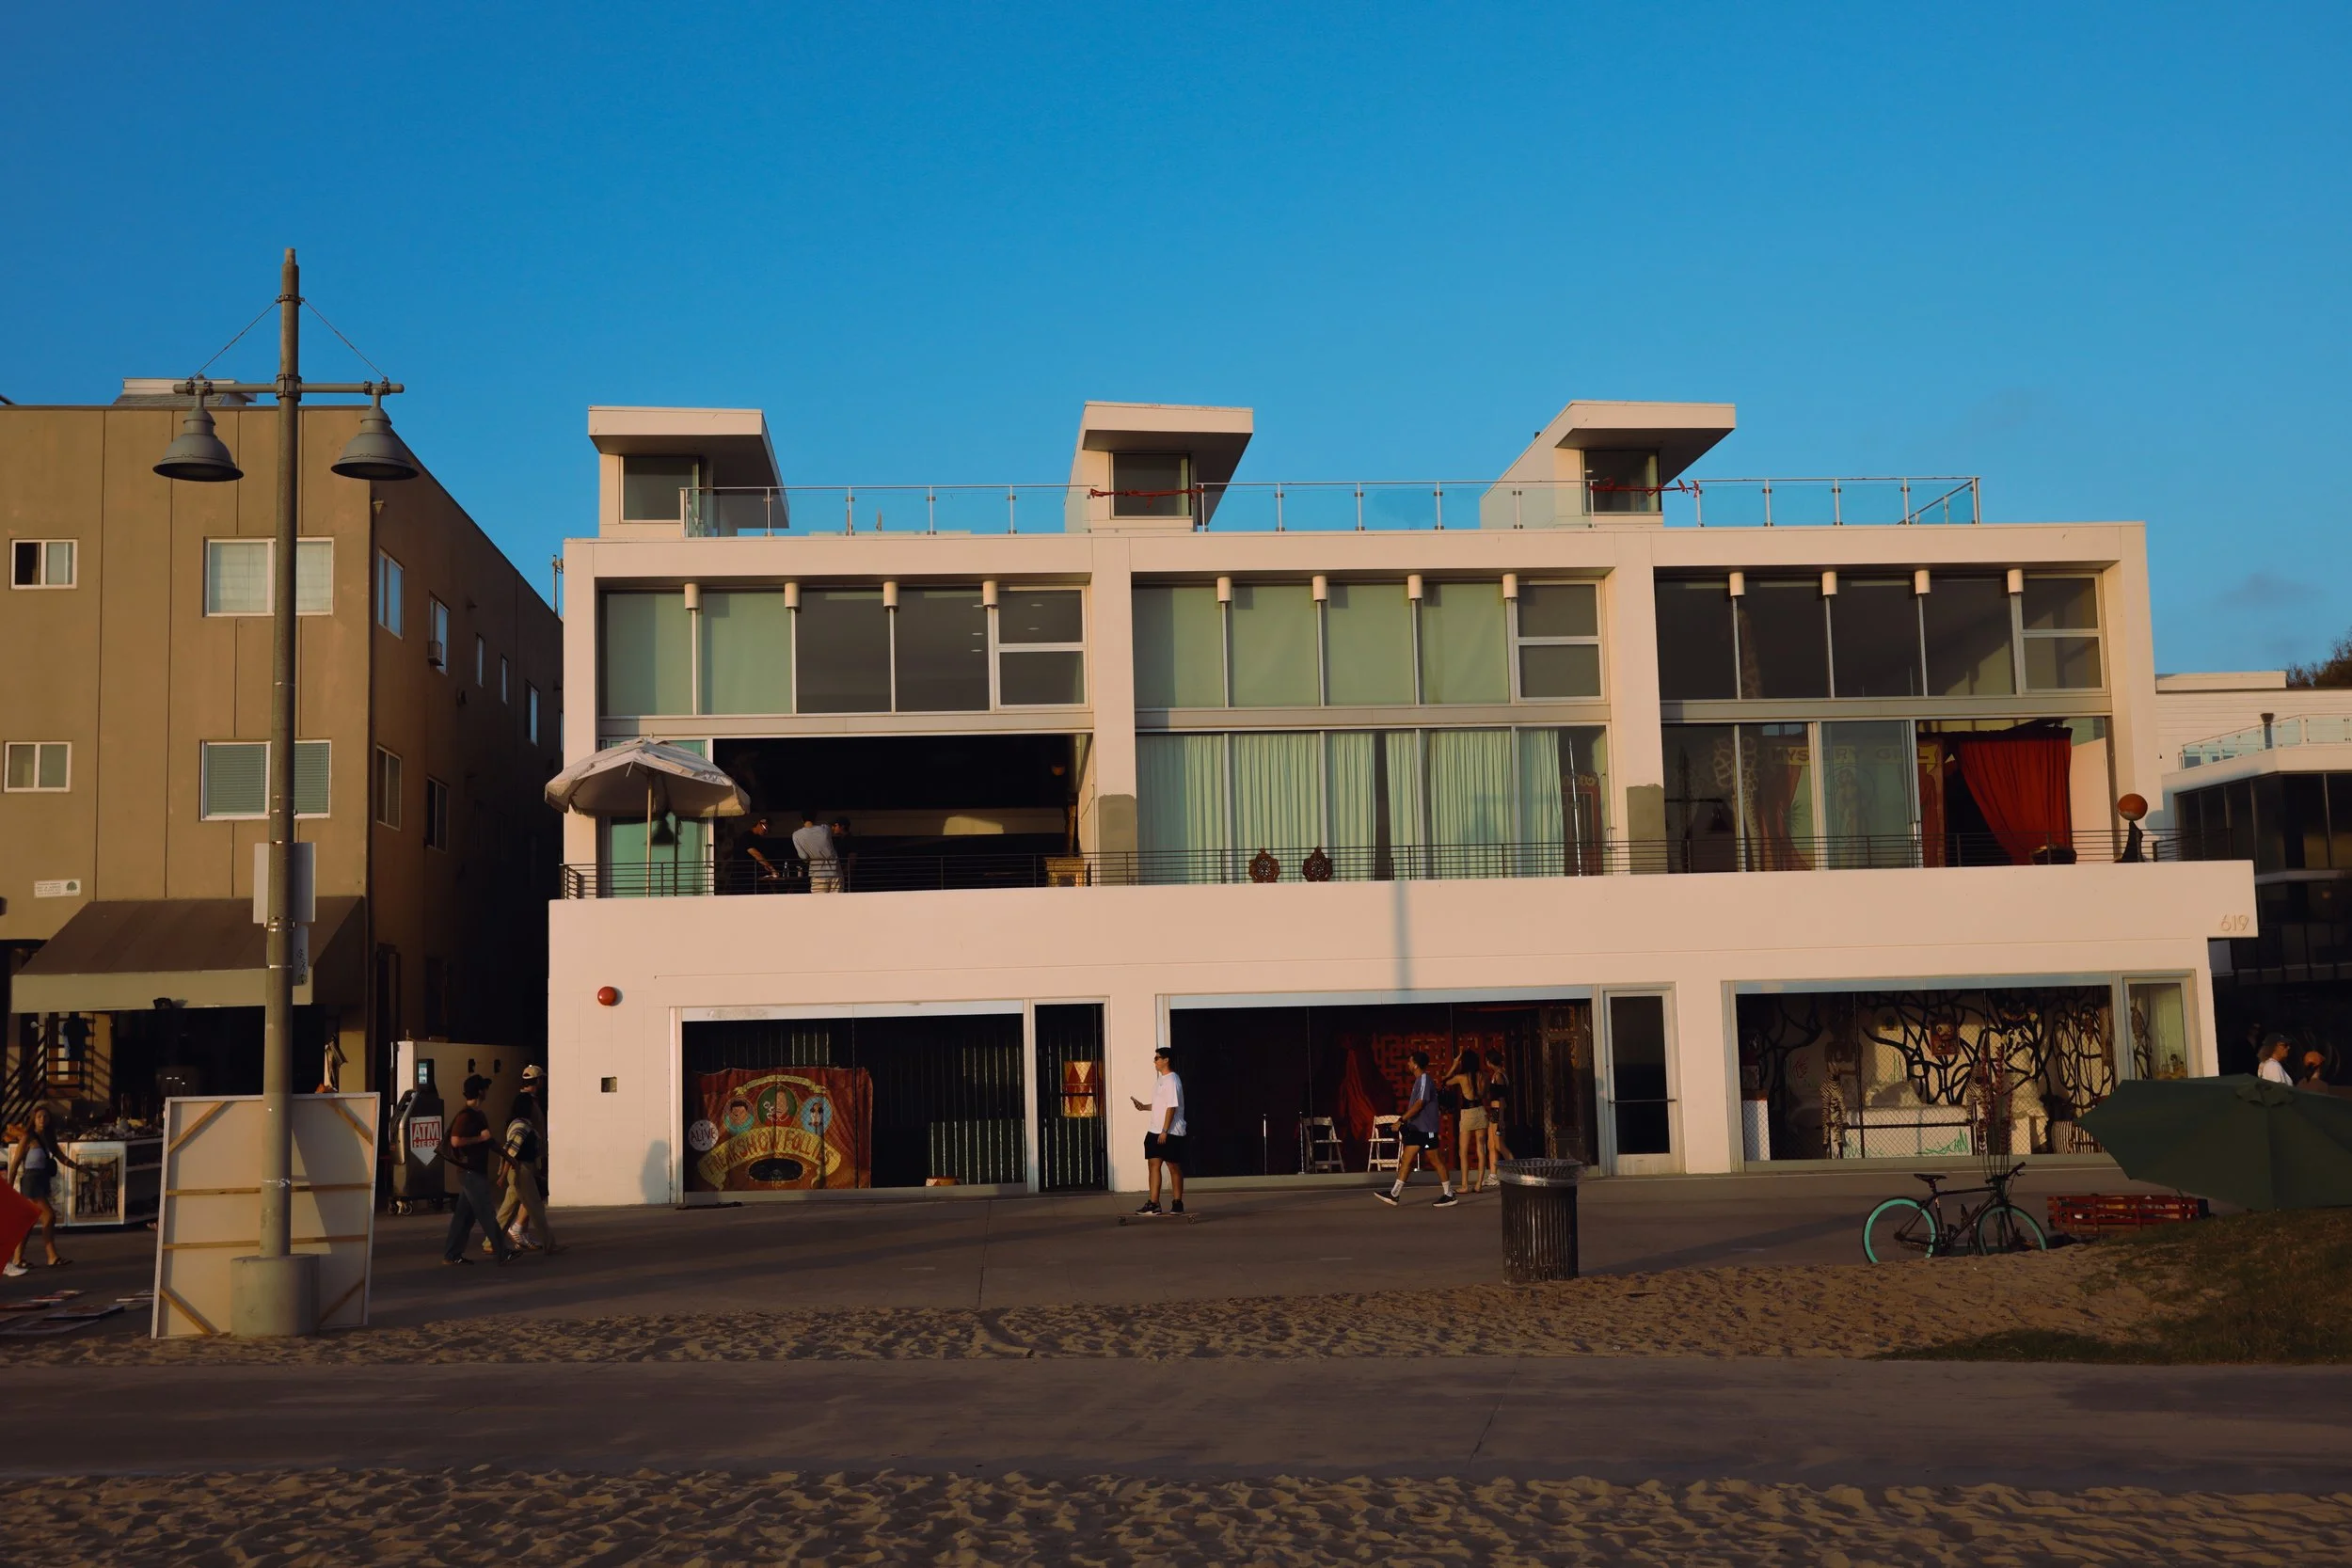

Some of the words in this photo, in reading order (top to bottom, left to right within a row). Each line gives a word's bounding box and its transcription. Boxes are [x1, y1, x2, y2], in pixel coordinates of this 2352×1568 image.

[2219, 914, 2249, 931] 619
[414, 1122, 439, 1140] ATM
[691, 1129, 716, 1142] ALIVE
[707, 1132, 783, 1174] FREAKSHOW
[784, 1130, 834, 1166] FOLLIES
